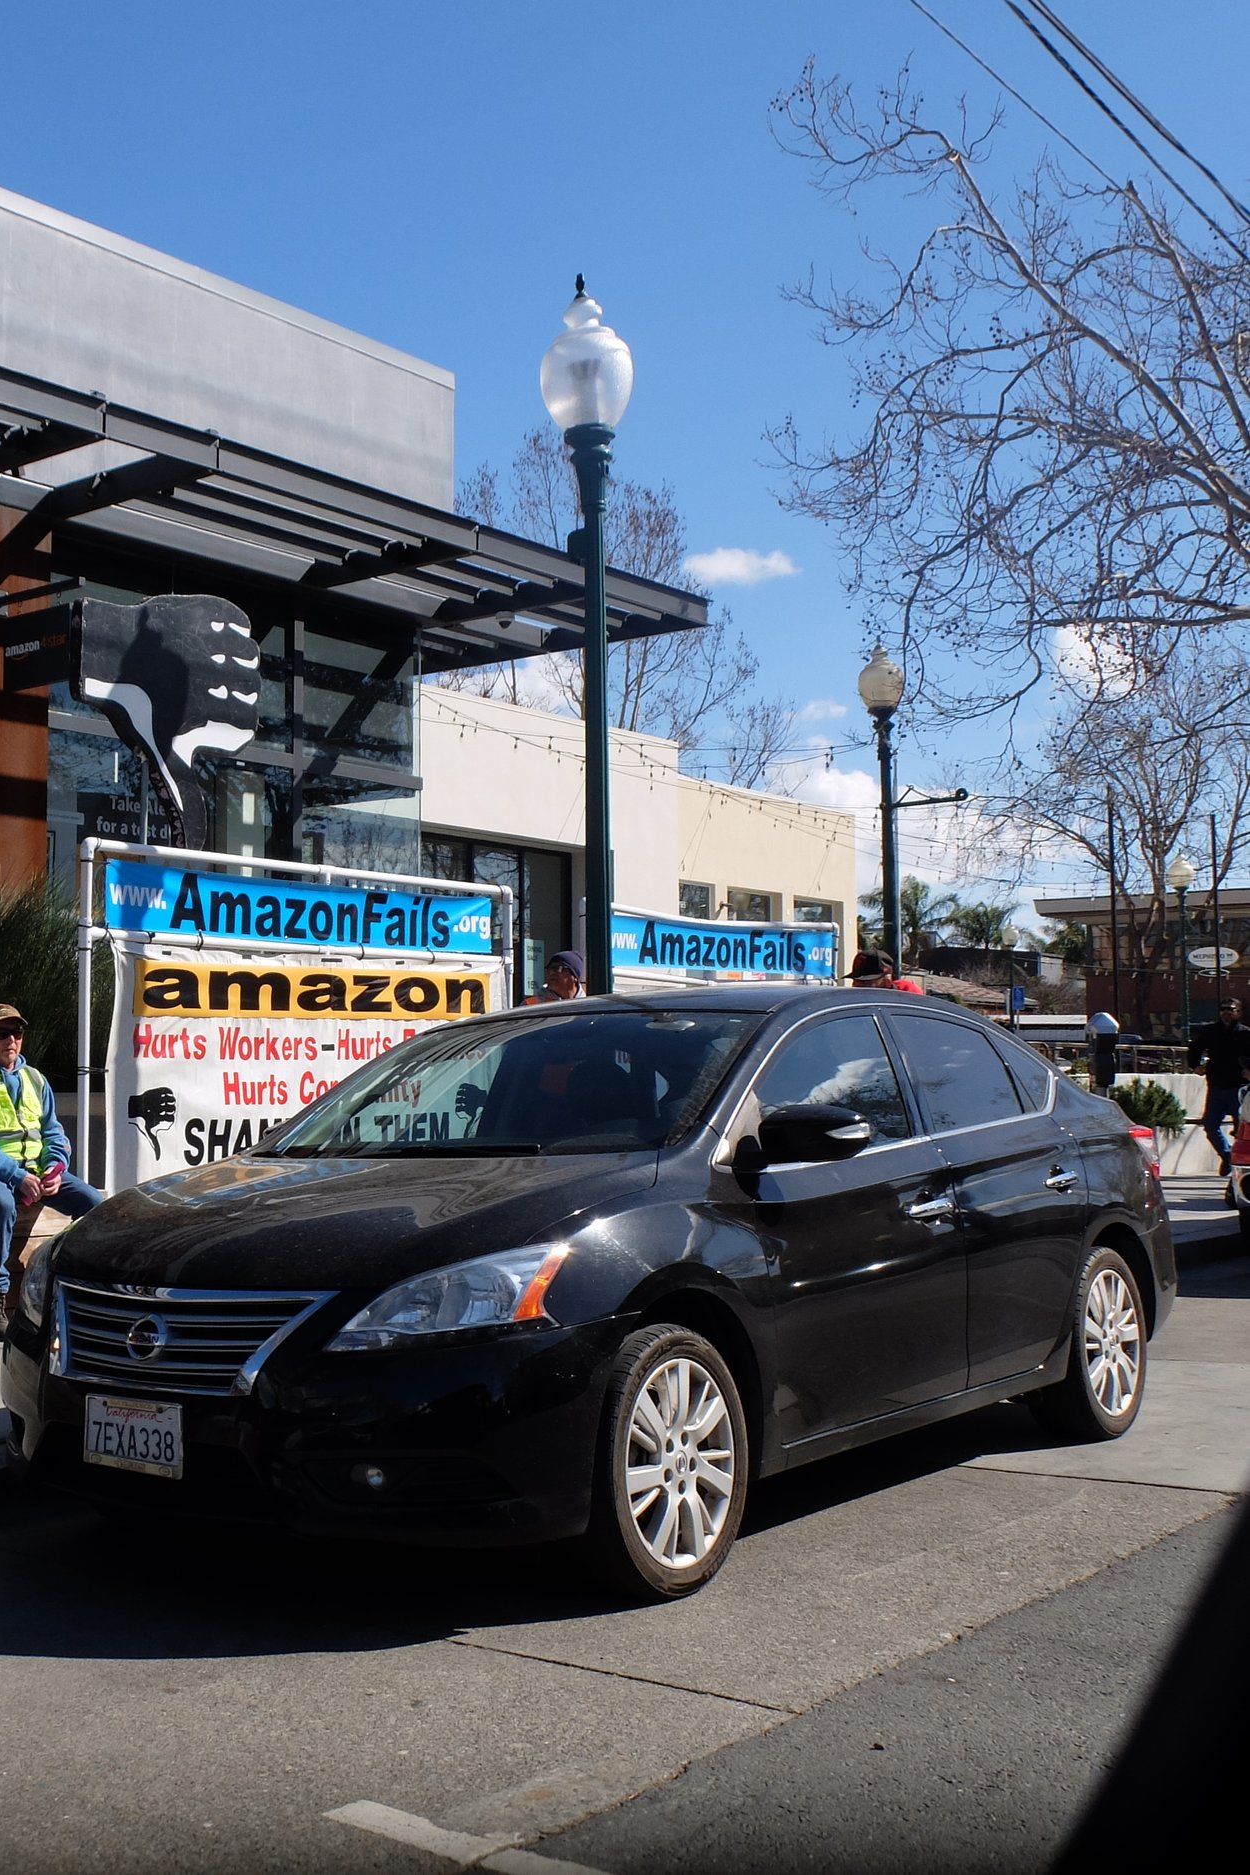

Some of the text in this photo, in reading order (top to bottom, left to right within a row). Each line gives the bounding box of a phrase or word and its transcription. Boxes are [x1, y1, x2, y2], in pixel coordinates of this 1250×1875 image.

[5, 640, 40, 657] amazon
[110, 795, 141, 813] Take
[96, 815, 117, 834] for
[120, 823, 129, 835] a
[143, 967, 486, 1015] amazon
[133, 1023, 207, 1060] Hurts
[223, 1071, 288, 1106] Hurts
[105, 1406, 163, 1424] California
[93, 1421, 174, 1462] 7EXA338
